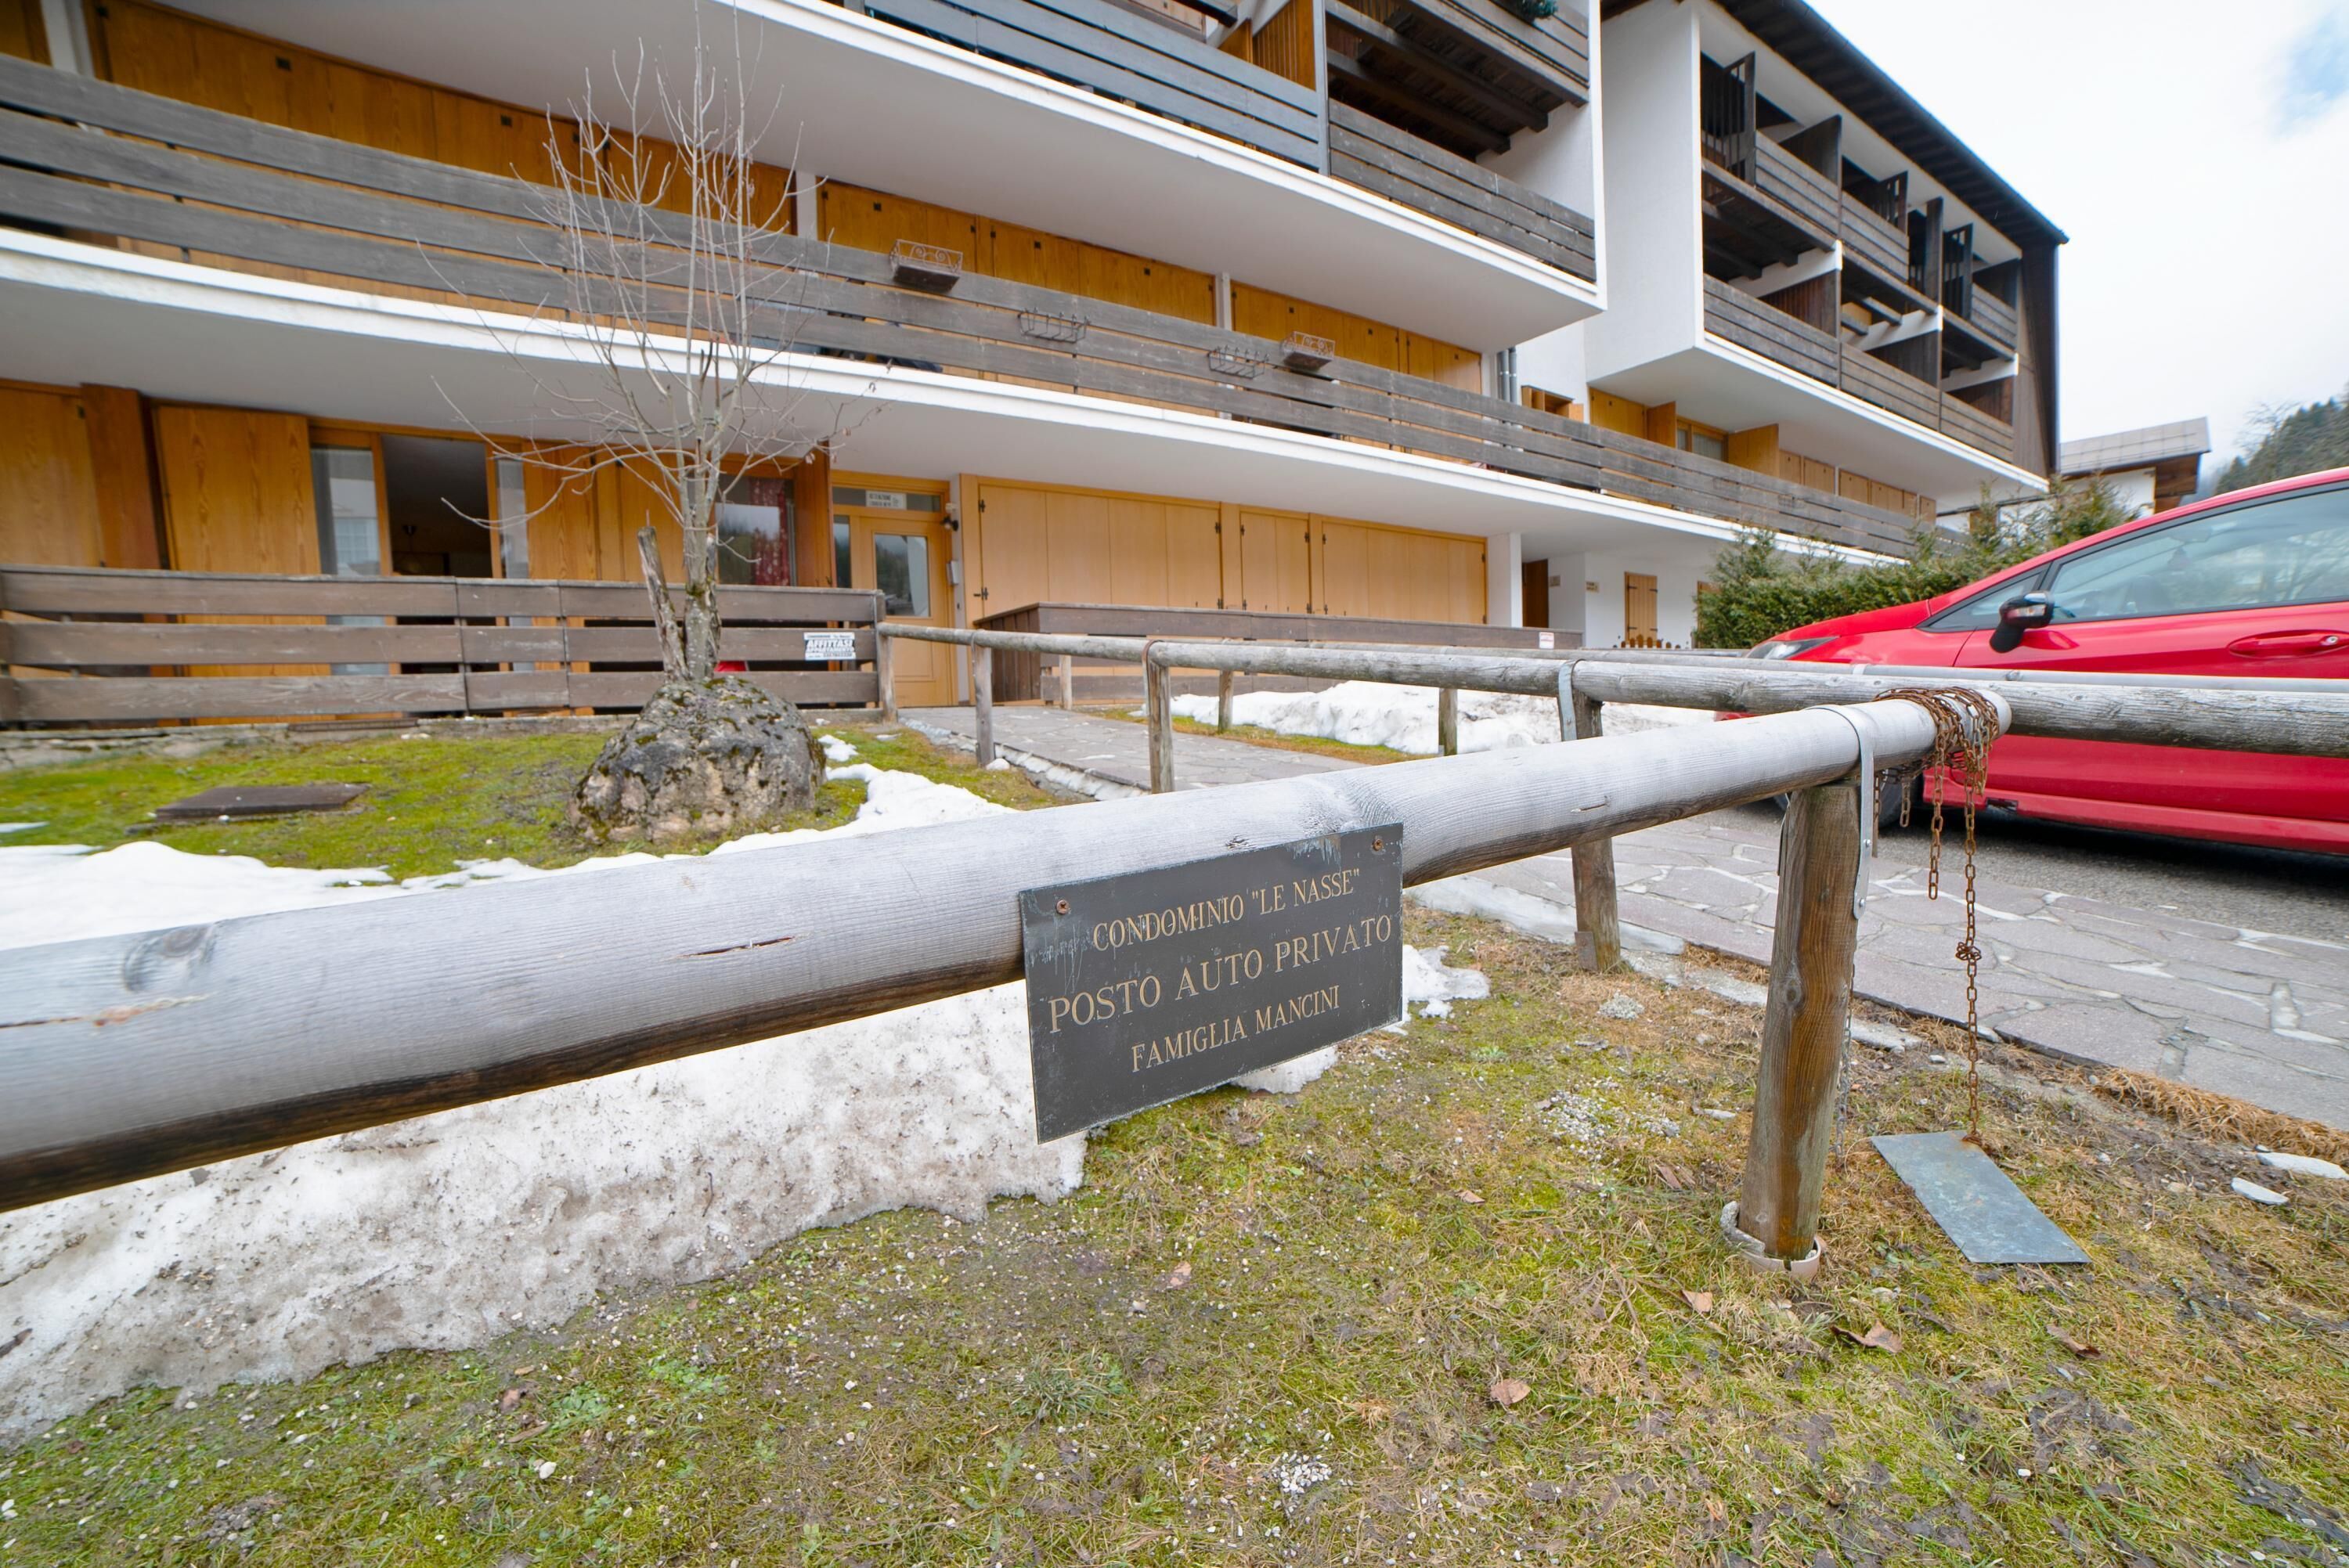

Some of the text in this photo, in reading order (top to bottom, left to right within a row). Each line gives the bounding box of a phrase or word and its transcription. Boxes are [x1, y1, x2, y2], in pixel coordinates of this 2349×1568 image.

[806, 639, 853, 647] AFFITTASI
[1093, 867, 1361, 952] CONDOMINIO "LE NASSE"
[1048, 914, 1392, 1033] POSTO AUTO PRIVATO
[1132, 985, 1340, 1073] FAMIGLIA MANCINI
